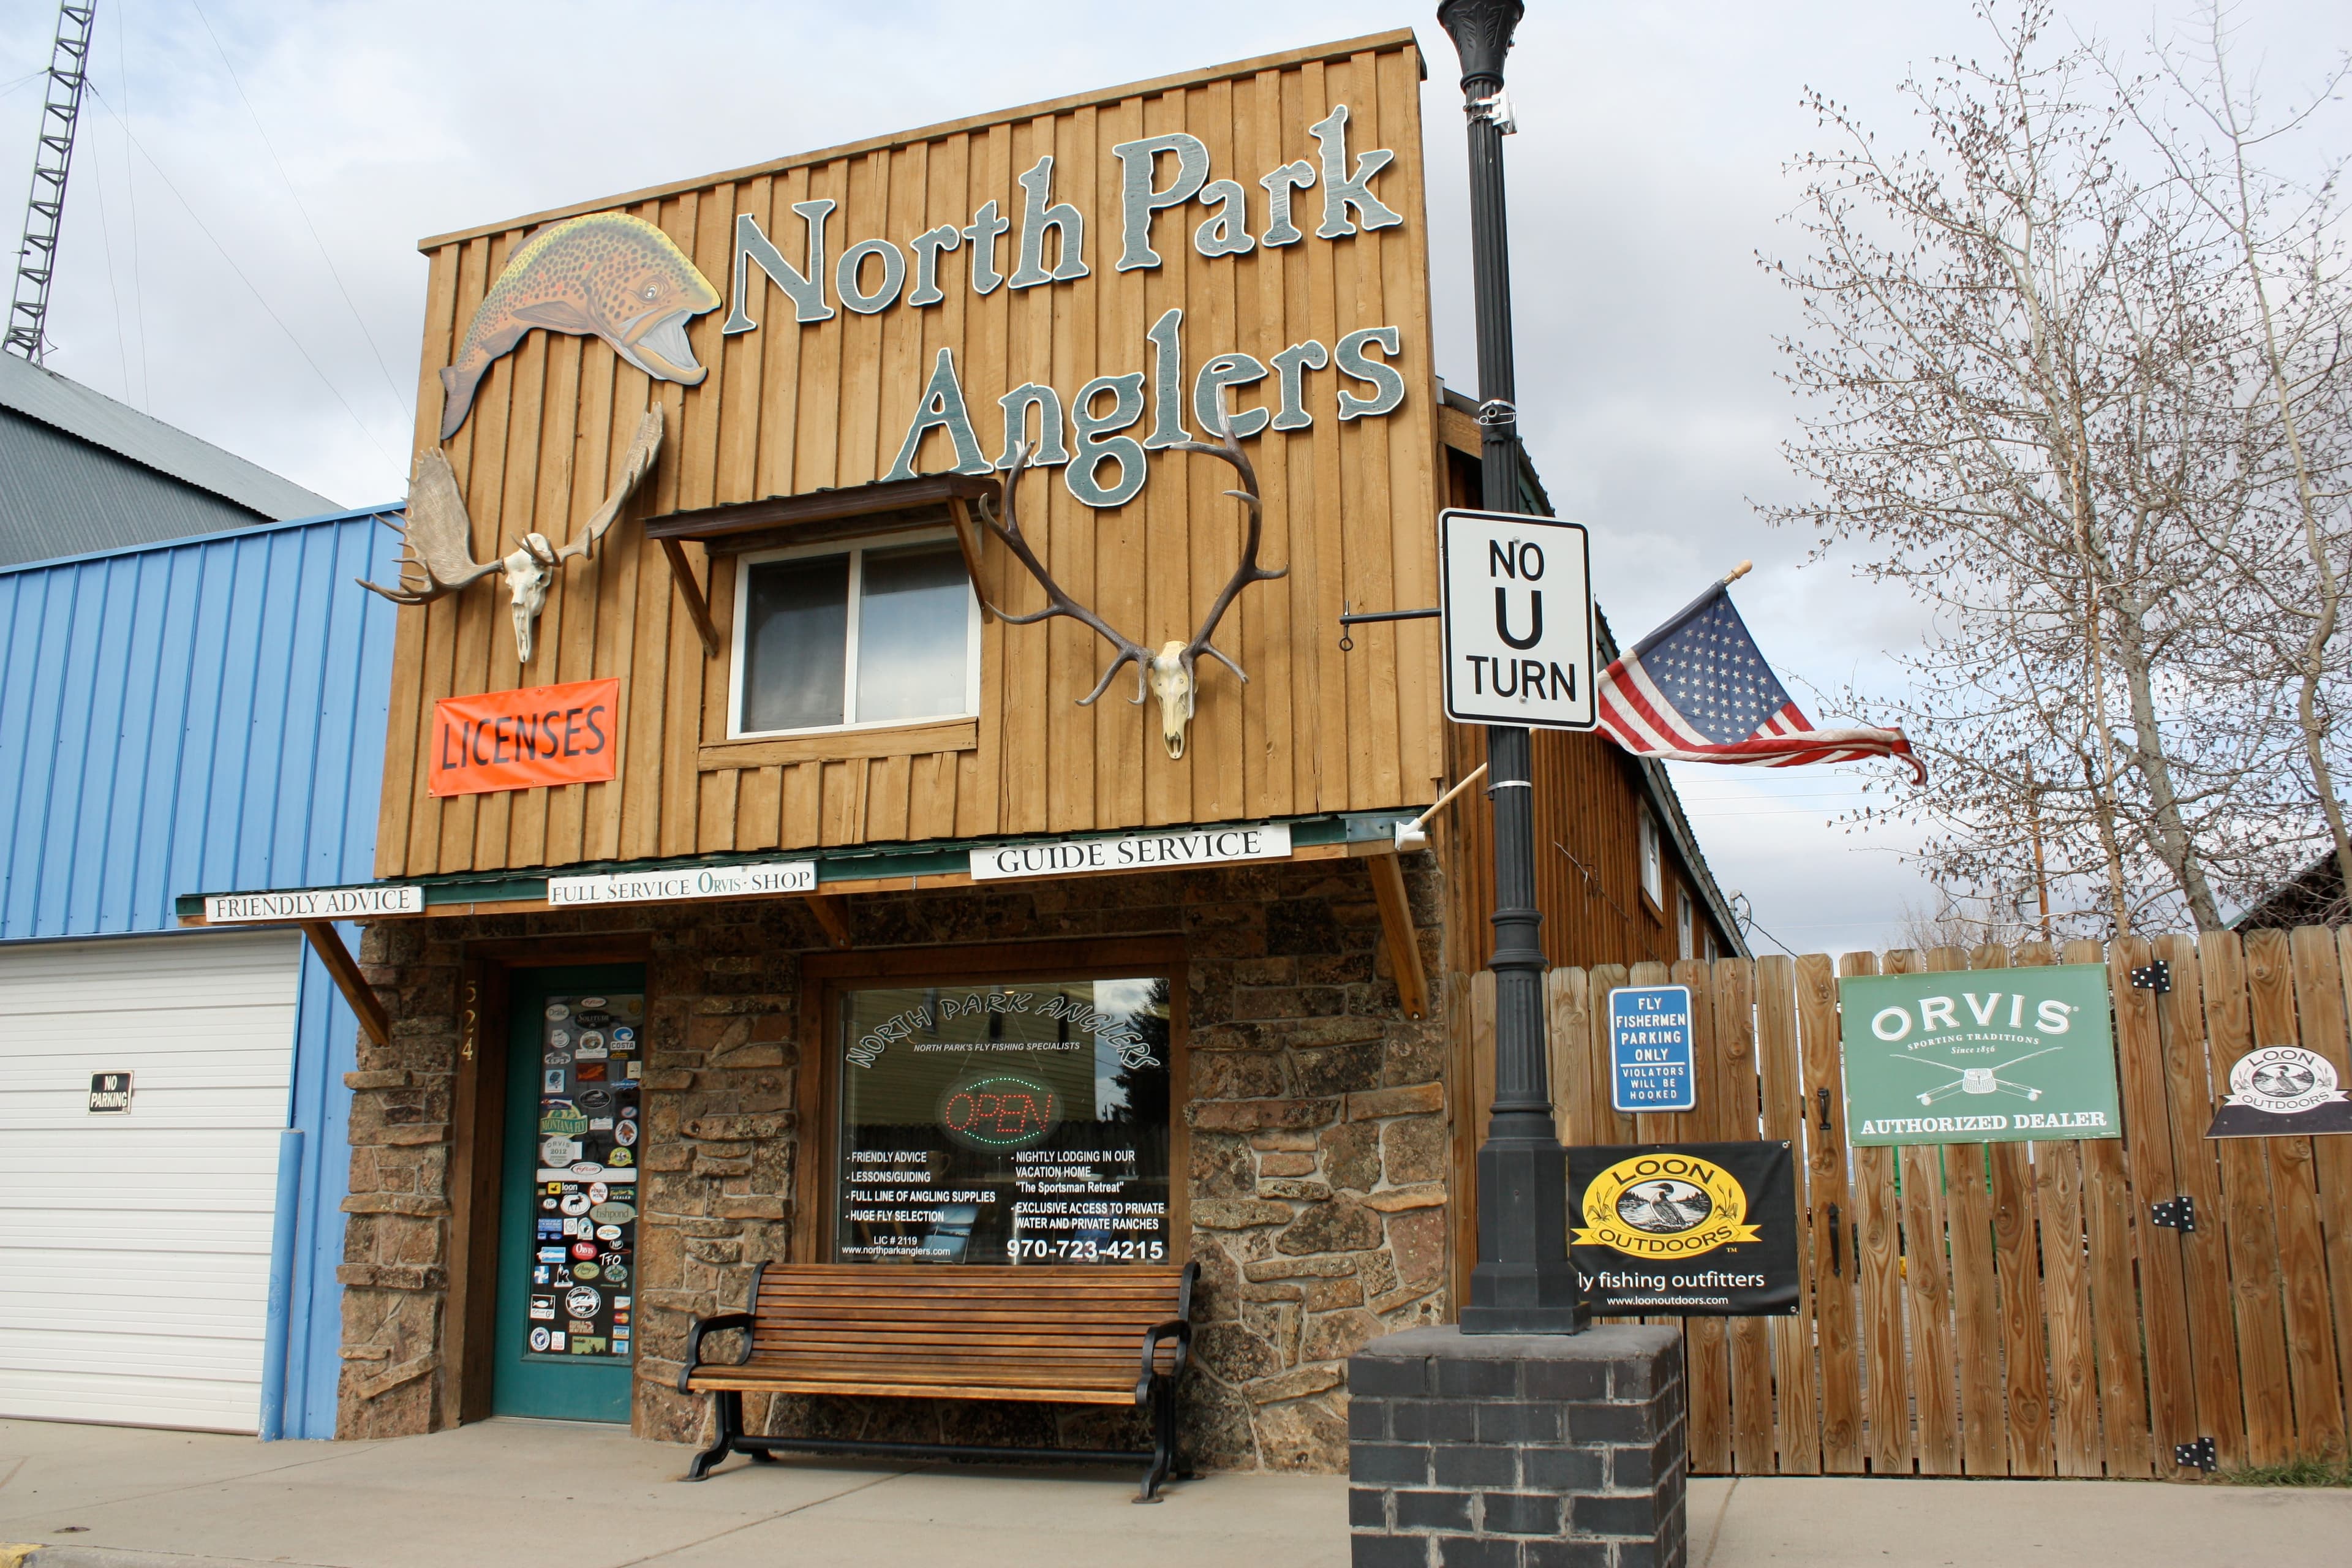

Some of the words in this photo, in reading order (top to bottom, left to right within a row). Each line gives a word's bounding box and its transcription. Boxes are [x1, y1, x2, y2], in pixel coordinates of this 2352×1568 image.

[722, 156, 1089, 334] North
[1112, 104, 1403, 273] Park
[879, 308, 1405, 508] Anglers
[1490, 539, 1544, 581] NO
[1495, 587, 1543, 650] U
[1466, 655, 1576, 702] TURN
[442, 705, 605, 770] LICENSES
[997, 843, 1106, 873] GUIDE
[1117, 831, 1262, 865] SERVICE
[552, 885, 600, 902] FULL
[607, 878, 691, 899] SERVICE
[752, 871, 810, 891] SHOP
[216, 892, 318, 918] FRIENDLY
[325, 890, 410, 912] ADVICE
[1638, 997, 1662, 1011] FLY
[1616, 1013, 1686, 1028] FISHERMEN
[1871, 992, 2072, 1041] ORVIS
[846, 1006, 932, 1069] NORTH
[940, 993, 1033, 1020] PARK
[1035, 996, 1161, 1069] ANGLERS
[1621, 1031, 1681, 1045] PARKING
[1027, 1042, 1080, 1050] SPECIALISTS
[1907, 1034, 1963, 1051] SPORTING
[1966, 1032, 2040, 1046] TRADITIONS
[1635, 1048, 1668, 1061] ONLY
[1951, 1046, 1975, 1054] Since
[1976, 1045, 1996, 1054] 1856
[2247, 1050, 2315, 1067] LOON
[1623, 1067, 1684, 1077] VIOLATORS
[104, 1075, 118, 1090] NO
[1630, 1080, 1655, 1088] WILL
[1663, 1079, 1676, 1087] BE
[91, 1091, 127, 1107] PARKING
[1630, 1090, 1677, 1099] HOOKED
[2242, 1091, 2331, 1109] OUTDOORS
[946, 1093, 1054, 1132] OPEN
[542, 1120, 573, 1133] MONTANA
[575, 1120, 586, 1133] FLY
[1861, 1114, 2008, 1135] AUTHORIZED
[2013, 1111, 2107, 1129] DEALER
[852, 1152, 893, 1163] FRIENDLY
[894, 1152, 927, 1163] ADVICE
[1016, 1151, 1055, 1163] NIGHTLY
[1057, 1151, 1100, 1162] LODGING
[1102, 1151, 1112, 1162] IN
[1114, 1150, 1135, 1161] OUR
[851, 1172, 930, 1183] LESSONS/GUIDING
[1016, 1166, 1061, 1177] VACATION
[1063, 1166, 1091, 1177] HOME
[1611, 1159, 1715, 1186] LOON
[1016, 1182, 1036, 1193] "The
[1038, 1182, 1085, 1195] Sportsman
[1088, 1181, 1124, 1193] Retreat"
[851, 1191, 872, 1202] FULL
[875, 1191, 894, 1202] LINE
[896, 1191, 909, 1202] OF
[910, 1191, 950, 1202] ANGLING
[952, 1191, 996, 1202] SUPPLIES
[596, 1207, 629, 1221] fishpond
[1016, 1202, 1067, 1213] EXCLUSIVE
[1069, 1202, 1107, 1214] ACCESS
[1110, 1203, 1123, 1214] TO
[1125, 1202, 1164, 1214] PRIVATE
[850, 1210, 875, 1221] HUGE
[877, 1210, 893, 1221] FLY
[895, 1210, 944, 1222] SELECTION
[1016, 1218, 1047, 1229] WATER
[1049, 1218, 1069, 1229] AND
[1072, 1218, 1110, 1229] PRIVATE
[1112, 1218, 1159, 1229] RANCHES
[873, 1236, 888, 1245] LIC
[898, 1236, 918, 1245] 2119
[1598, 1226, 1733, 1253] OUTDOORS
[842, 1246, 951, 1256] www.northparkanglers.com
[1007, 1240, 1163, 1259] 970-723-4215
[599, 1252, 621, 1265] TFO
[1578, 1271, 1594, 1292] ly
[1599, 1271, 1666, 1292] fishing
[1672, 1270, 1765, 1287] outfitters
[1607, 1295, 1729, 1306] www.loonoutdoors.com
